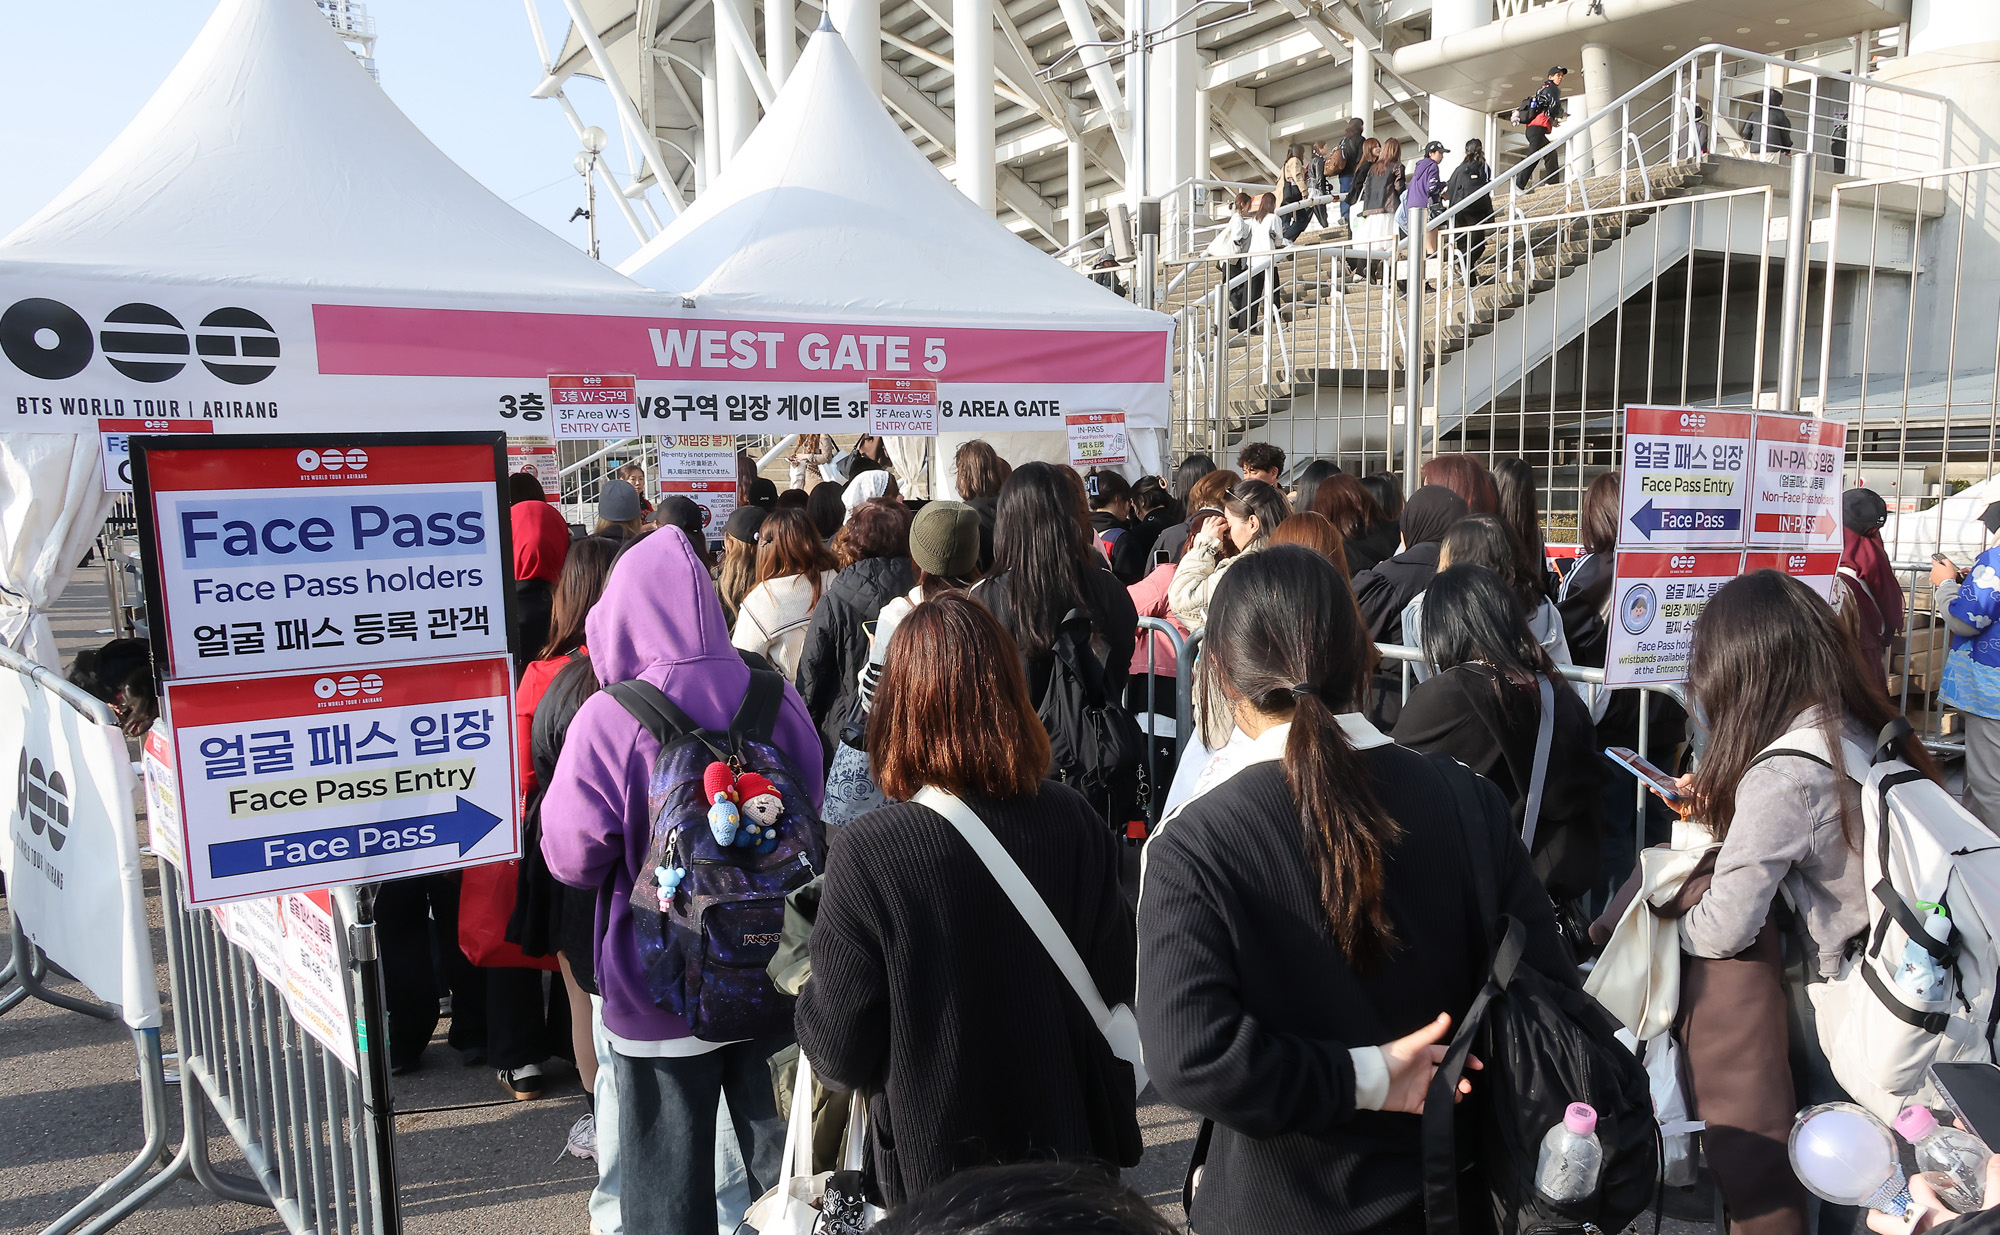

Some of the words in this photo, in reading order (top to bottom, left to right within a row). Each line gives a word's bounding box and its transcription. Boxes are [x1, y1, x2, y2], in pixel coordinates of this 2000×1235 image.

[648, 328, 785, 370] WEST
[798, 333, 911, 372] GATE
[922, 337, 948, 373] 5
[560, 391, 578, 402] 3층
[581, 391, 627, 402] W-S구역
[17, 396, 52, 415] BTS
[59, 397, 125, 417] WORLD
[133, 399, 181, 418] TOUR
[203, 400, 279, 419] ARIRANG
[499, 393, 545, 422] 3층
[725, 394, 771, 422] 입장
[777, 395, 842, 422] 게이트
[848, 400, 869, 418] 3F
[959, 401, 1010, 417] AREA
[1014, 401, 1060, 417] GATE
[560, 409, 574, 419] 3F
[577, 409, 603, 419] Area
[605, 409, 630, 419] W-S
[876, 408, 887, 418] 3F
[889, 409, 910, 418] Area
[912, 409, 932, 418] W-S
[561, 423, 599, 433] ENTRY
[601, 422, 631, 433] GATE
[876, 421, 906, 430] ENTRY
[908, 421, 932, 430] GATE
[107, 437, 129, 452] Fa
[1634, 442, 1670, 469] 얼굴
[1674, 443, 1707, 470] 패스
[1712, 444, 1743, 471] 입장
[1768, 448, 1819, 471] IN-PASS
[1820, 452, 1835, 473] 입장
[1641, 476, 1672, 492] Face
[1674, 477, 1701, 493] Pass
[1703, 478, 1734, 496] Entry
[1762, 490, 1800, 503] Non-Face
[1661, 511, 1693, 528] Face
[1695, 511, 1725, 528] Pass
[1778, 515, 1817, 533] IN-PASS
[181, 510, 335, 559] Face
[350, 504, 486, 550] Pass
[192, 578, 276, 605] Face
[283, 572, 359, 600] Pass
[366, 564, 484, 594] holders
[1665, 583, 1685, 600] 얼굴
[1686, 583, 1705, 599] 패스
[193, 620, 266, 659] 얼굴
[274, 616, 345, 652] 패스
[353, 609, 419, 646] 등록
[426, 604, 490, 640] 관객
[1637, 641, 1656, 652] Face
[1657, 640, 1675, 651] Pass
[1618, 654, 1656, 664] wristbands
[1657, 652, 1685, 663] available
[1642, 666, 1654, 674] the
[1656, 665, 1685, 674] Entrance
[200, 729, 295, 781] 얼굴
[307, 720, 399, 767] 패스
[410, 708, 495, 757] 입장
[228, 787, 308, 816] Face
[315, 778, 388, 805] Pass
[394, 765, 477, 795] Entry
[264, 837, 350, 868] Face
[357, 823, 437, 855] Pass
[743, 933, 781, 946] JANSPO
